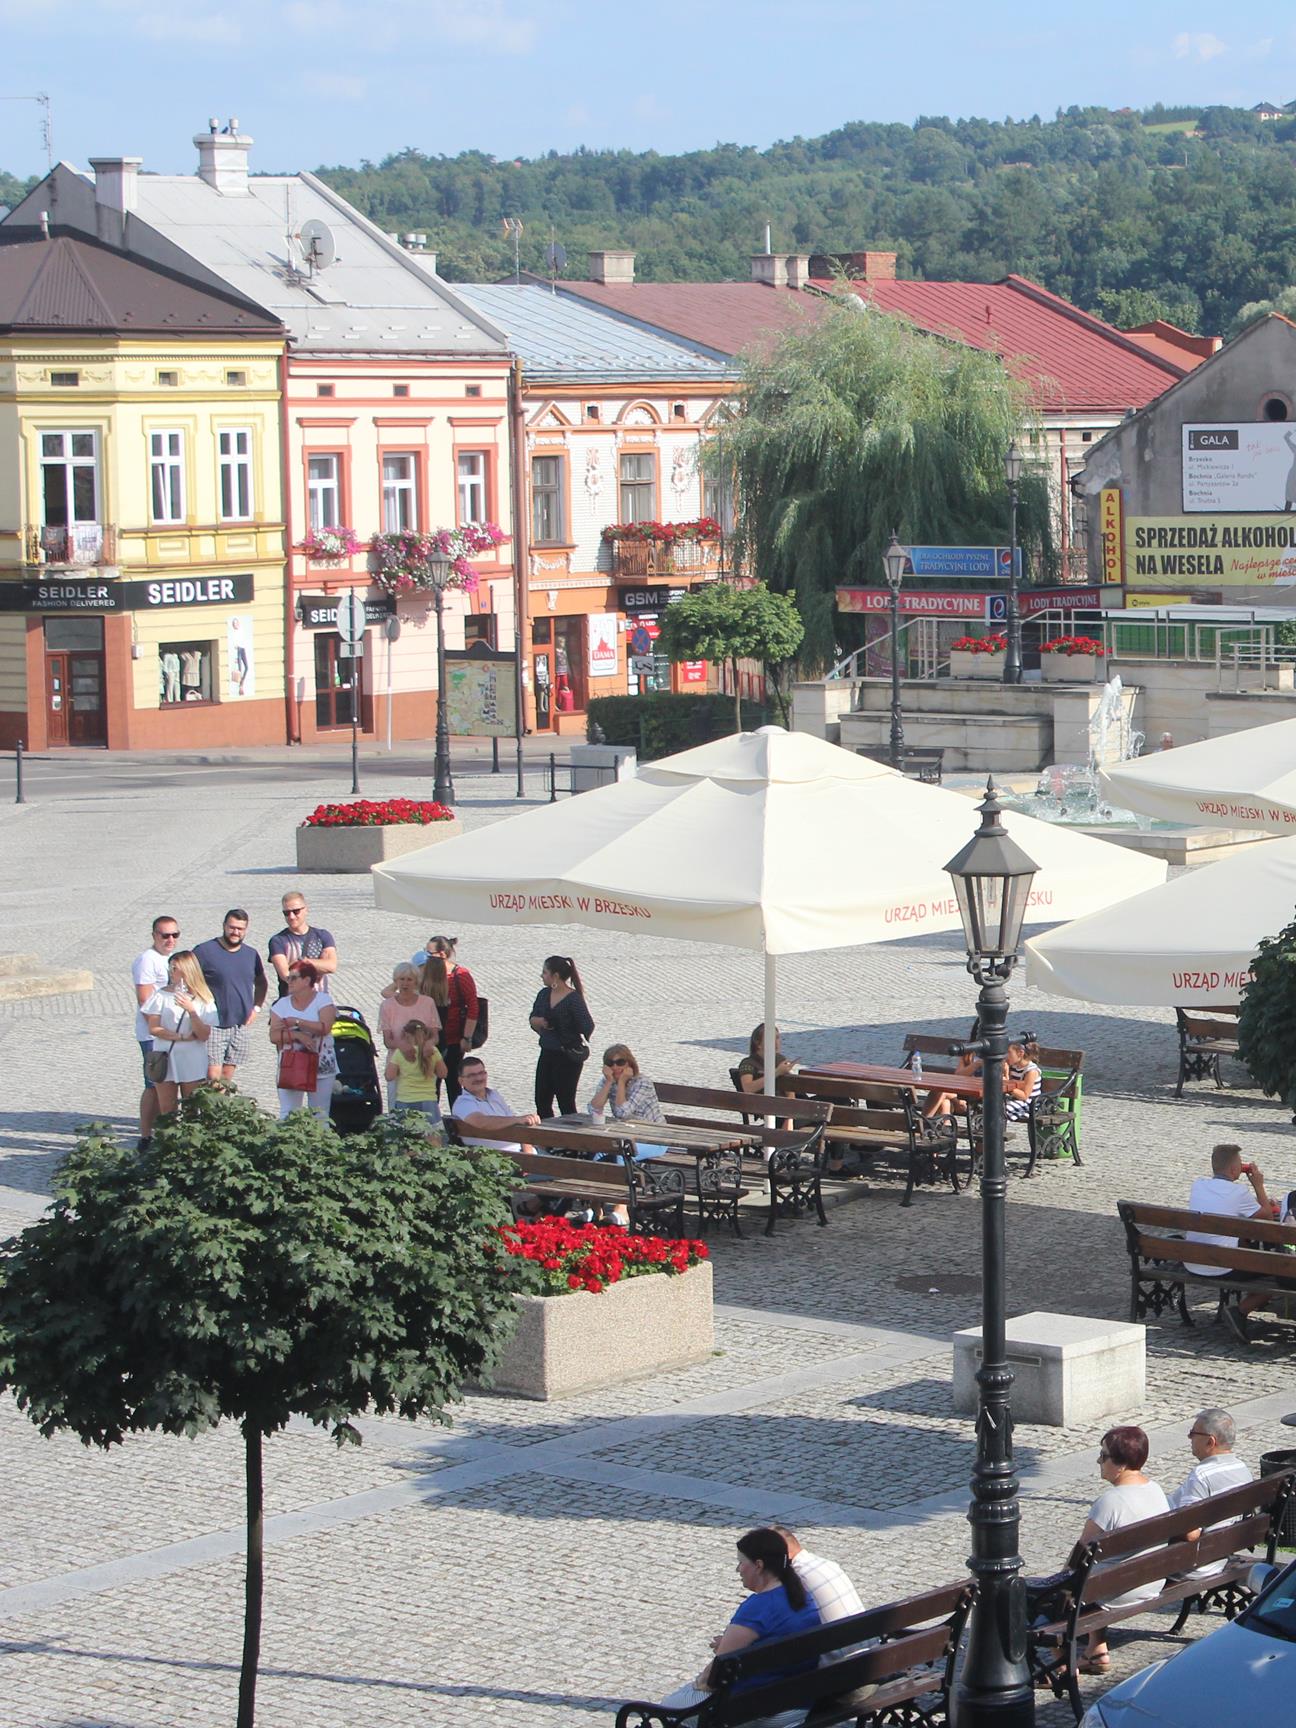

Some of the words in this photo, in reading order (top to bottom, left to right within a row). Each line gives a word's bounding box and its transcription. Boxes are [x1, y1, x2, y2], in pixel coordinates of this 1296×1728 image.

[1200, 435, 1230, 445] GALA
[1105, 492, 1116, 582] ALKOHOL
[1135, 523, 1219, 549] SPRZEDAŻ
[920, 561, 967, 573] TRADYCYJNE
[969, 562, 991, 571] LODY
[1136, 554, 1158, 575] NA
[1160, 554, 1225, 575] WESELA
[1230, 556, 1281, 574] Najlepsze
[38, 585, 109, 599] SEIDLER
[148, 578, 235, 604] SEIDLER
[625, 591, 658, 606] GSM
[70, 599, 116, 607] DELIVERED
[904, 596, 981, 613] TRADYCYJNE
[1029, 597, 1050, 609] LODY
[1052, 593, 1097, 607] TRADYCYJNE
[310, 608, 338, 623] SEID
[593, 650, 615, 659] DAMA
[1195, 801, 1228, 817] URZĄD
[1230, 805, 1265, 821] MIEJSKI
[1268, 809, 1280, 821] W
[489, 894, 526, 912] URZĄD
[528, 895, 574, 910] MIEJSKI
[577, 897, 590, 911] W
[595, 898, 652, 918] BRZESKU
[884, 903, 927, 923] URZĄD
[1172, 972, 1220, 992] URZĄD
